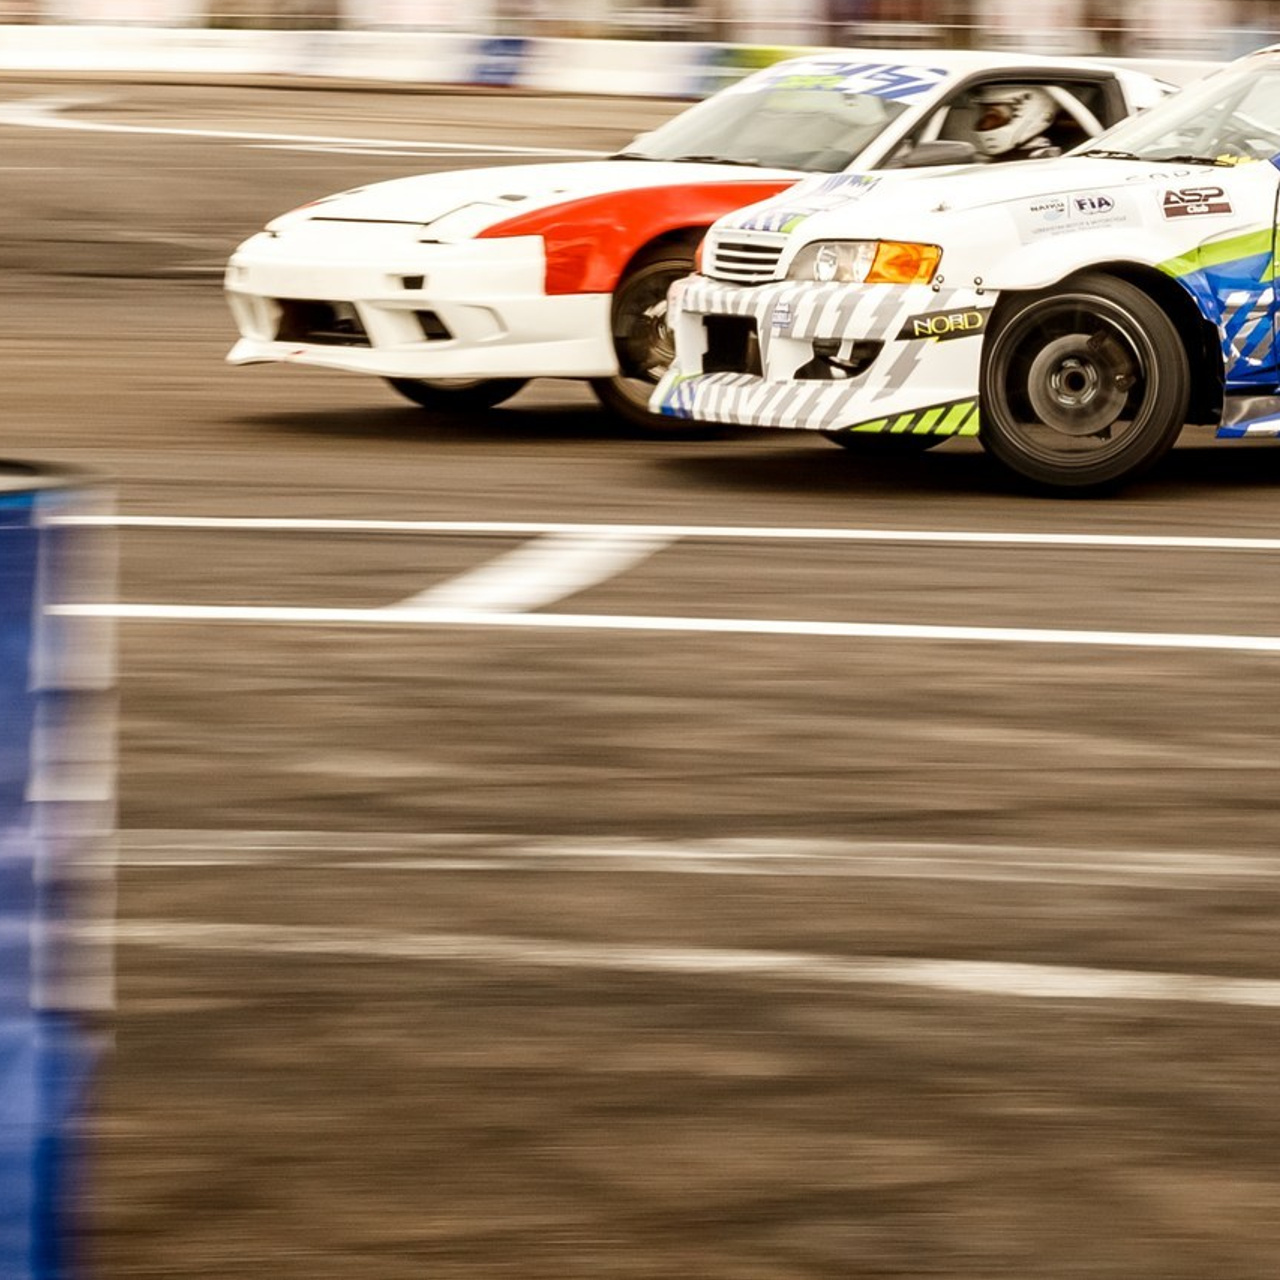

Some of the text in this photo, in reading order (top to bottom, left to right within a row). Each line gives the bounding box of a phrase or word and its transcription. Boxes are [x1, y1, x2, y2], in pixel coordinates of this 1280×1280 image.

[1075, 197, 1111, 211] FIA
[1163, 187, 1224, 206] ASP
[913, 311, 983, 336] NORD
